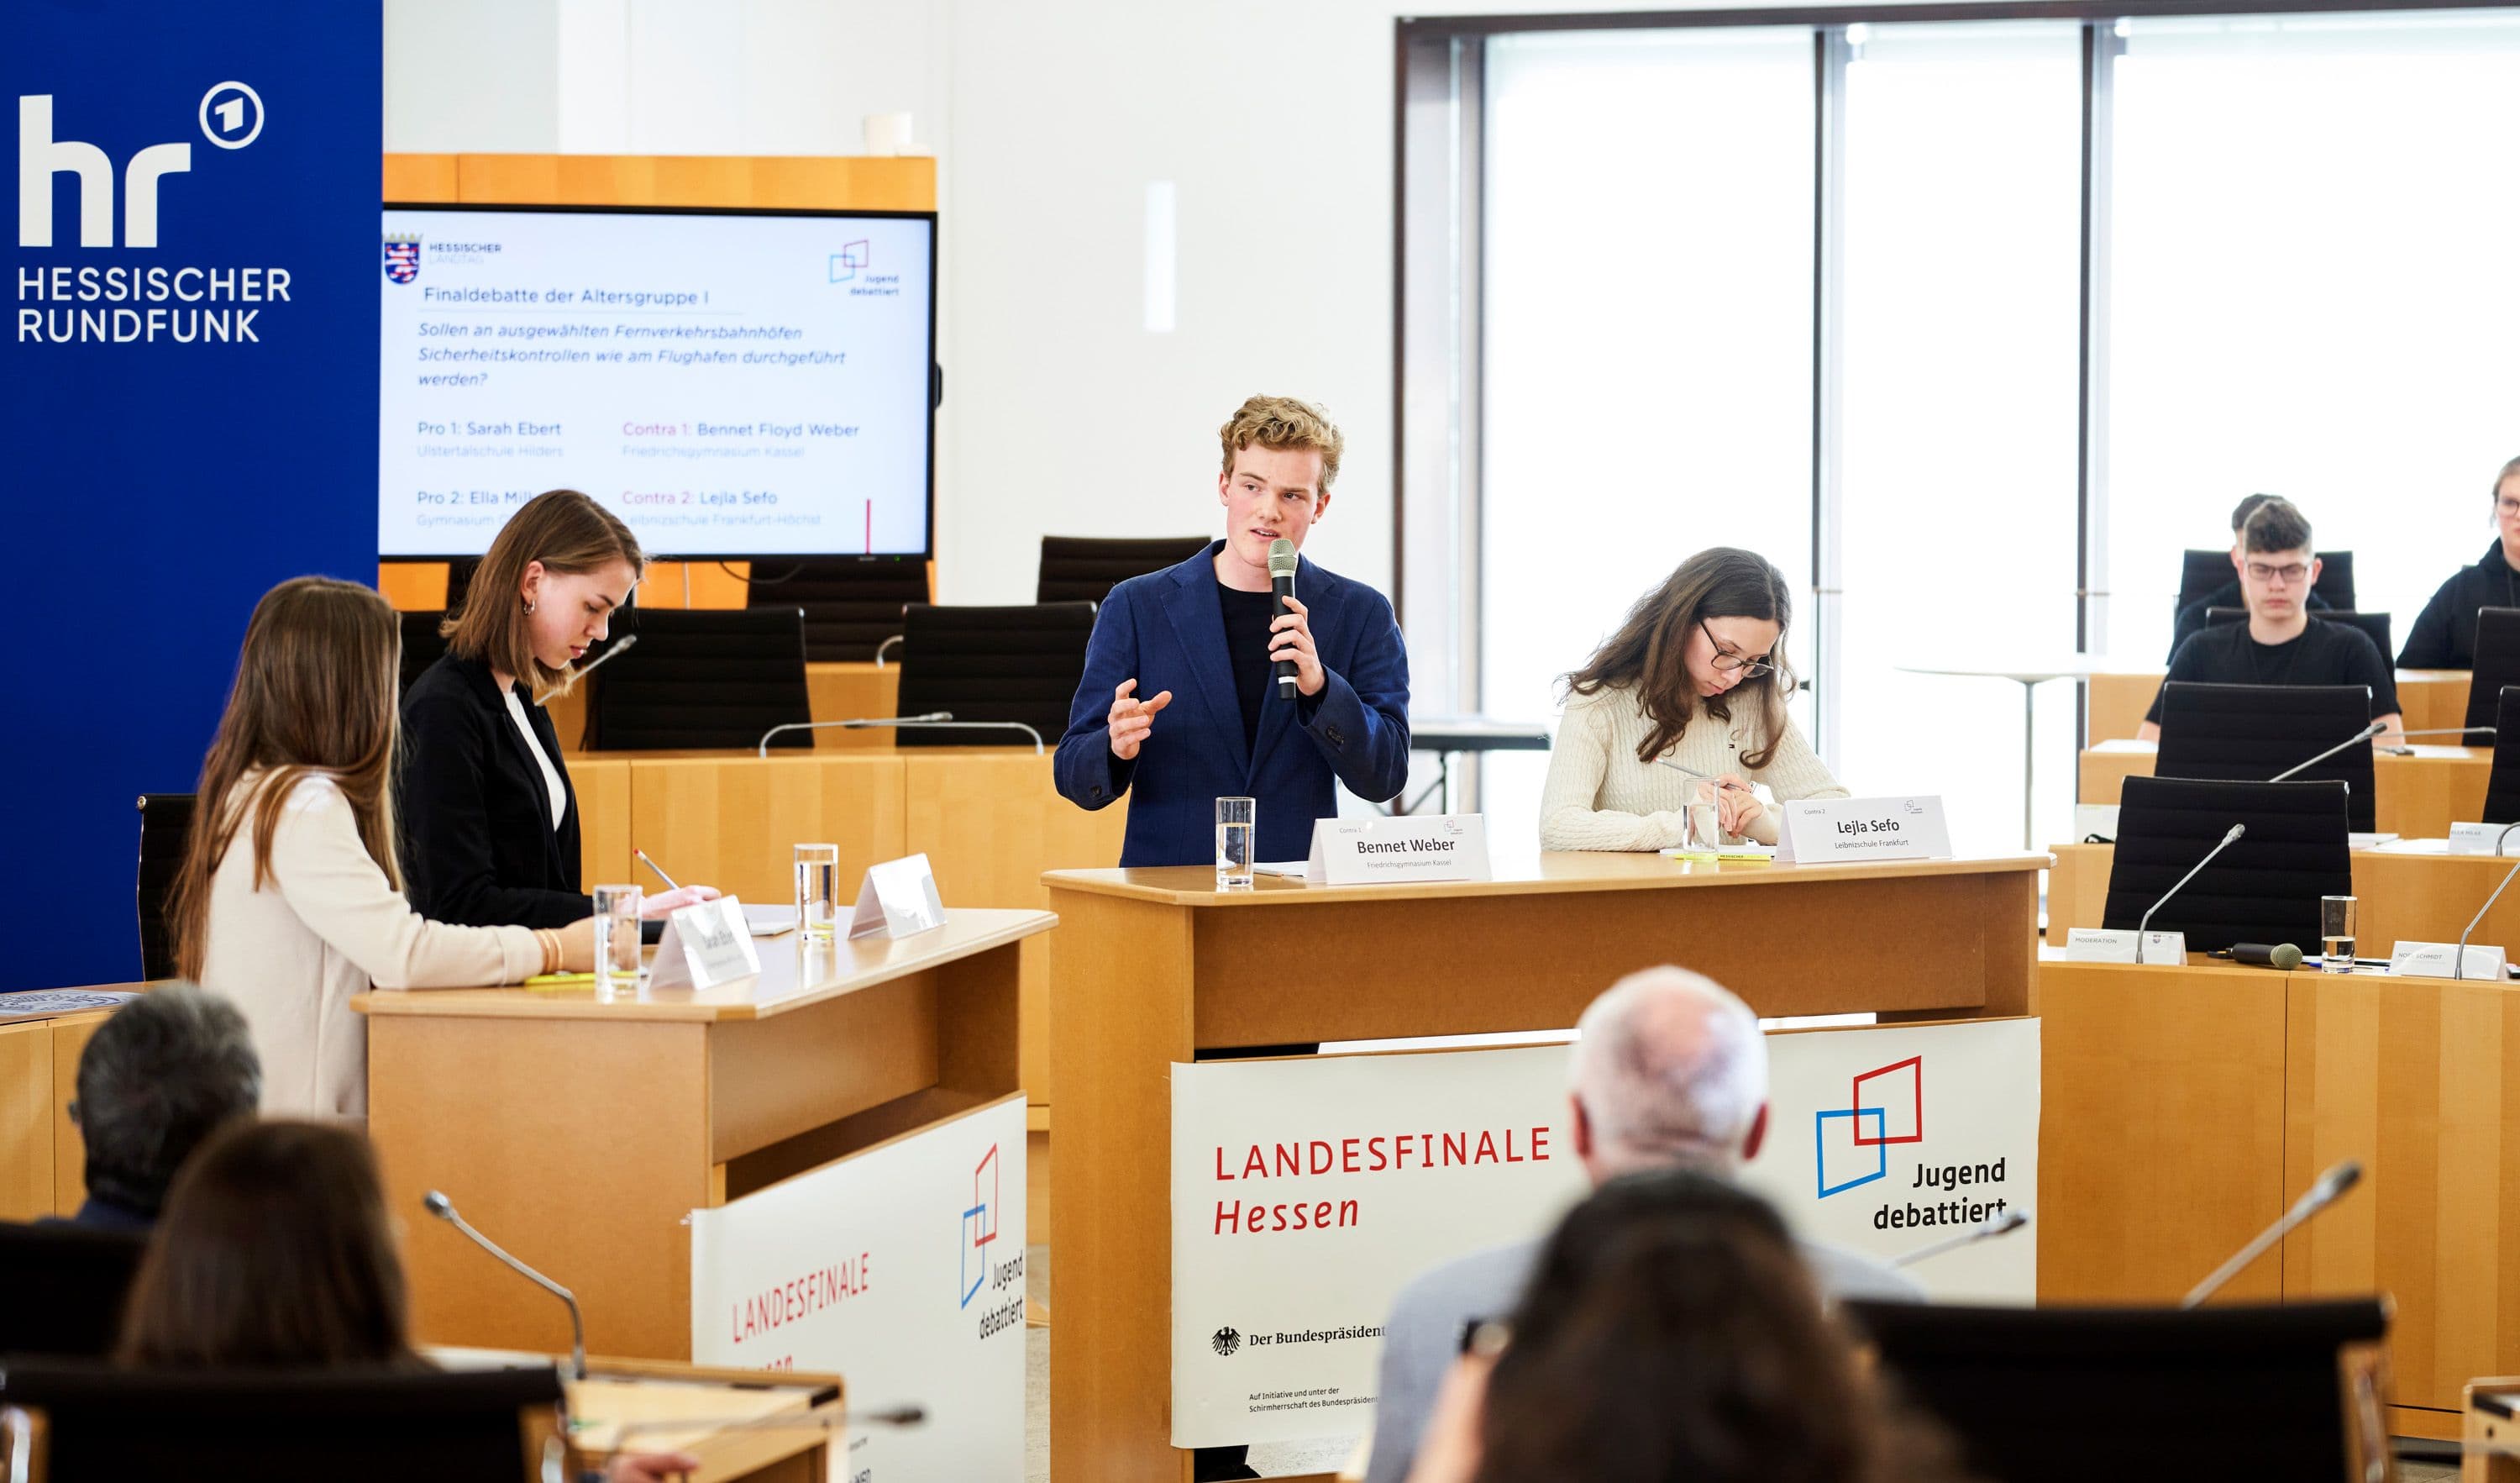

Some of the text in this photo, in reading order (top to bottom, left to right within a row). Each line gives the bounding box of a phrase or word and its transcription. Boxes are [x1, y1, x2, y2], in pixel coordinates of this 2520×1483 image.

[19, 94, 192, 248] hr
[429, 243, 502, 253] HESSISCHER
[18, 267, 291, 302] HESSISCHER
[424, 287, 538, 303] Finaldebatte
[545, 289, 574, 303] der
[581, 290, 698, 306] Altersgruppe
[18, 309, 260, 343] RUNDFUNK
[418, 323, 803, 340] Sollen an ausgewählten Fernverkehrsbahnhöfen
[418, 348, 847, 366] Sicherheitskontrollen wie am Flughafen durchgeführt
[418, 372, 488, 387] werden?
[417, 422, 561, 436] Pro 1: Sarah Ebert
[622, 423, 860, 439] Contra 1: Bennet Floyd Weber
[417, 491, 445, 504] Pro
[450, 491, 464, 504] 2:
[470, 491, 498, 504] Ella
[622, 492, 778, 507] Contra 2: Lejla Sefo
[417, 513, 494, 528] Gymnasium
[1837, 818, 1900, 835] Lejla Sefo
[1357, 838, 1455, 854] Bennet Weber
[1835, 839, 1908, 849] Leibnizschule Frankfurt
[1367, 860, 1431, 870] Friedrichsgymnasium
[1215, 1127, 1550, 1181] LANDESFINALE
[1913, 1157, 2006, 1191] Jugend
[1214, 1199, 1359, 1235] Hessen
[1873, 1196, 2007, 1229] debattiert
[992, 1250, 1023, 1291] Jugend
[732, 1252, 870, 1344] LANDESFINALE
[979, 1298, 1023, 1339] debattiert
[1249, 1334, 1273, 1346] Der
[1263, 1391, 1293, 1400] Initiative
[1294, 1389, 1307, 1397] und
[1309, 1388, 1327, 1396] unter
[1249, 1396, 1378, 1412] Schirmherrschaft des Bundespräsident
